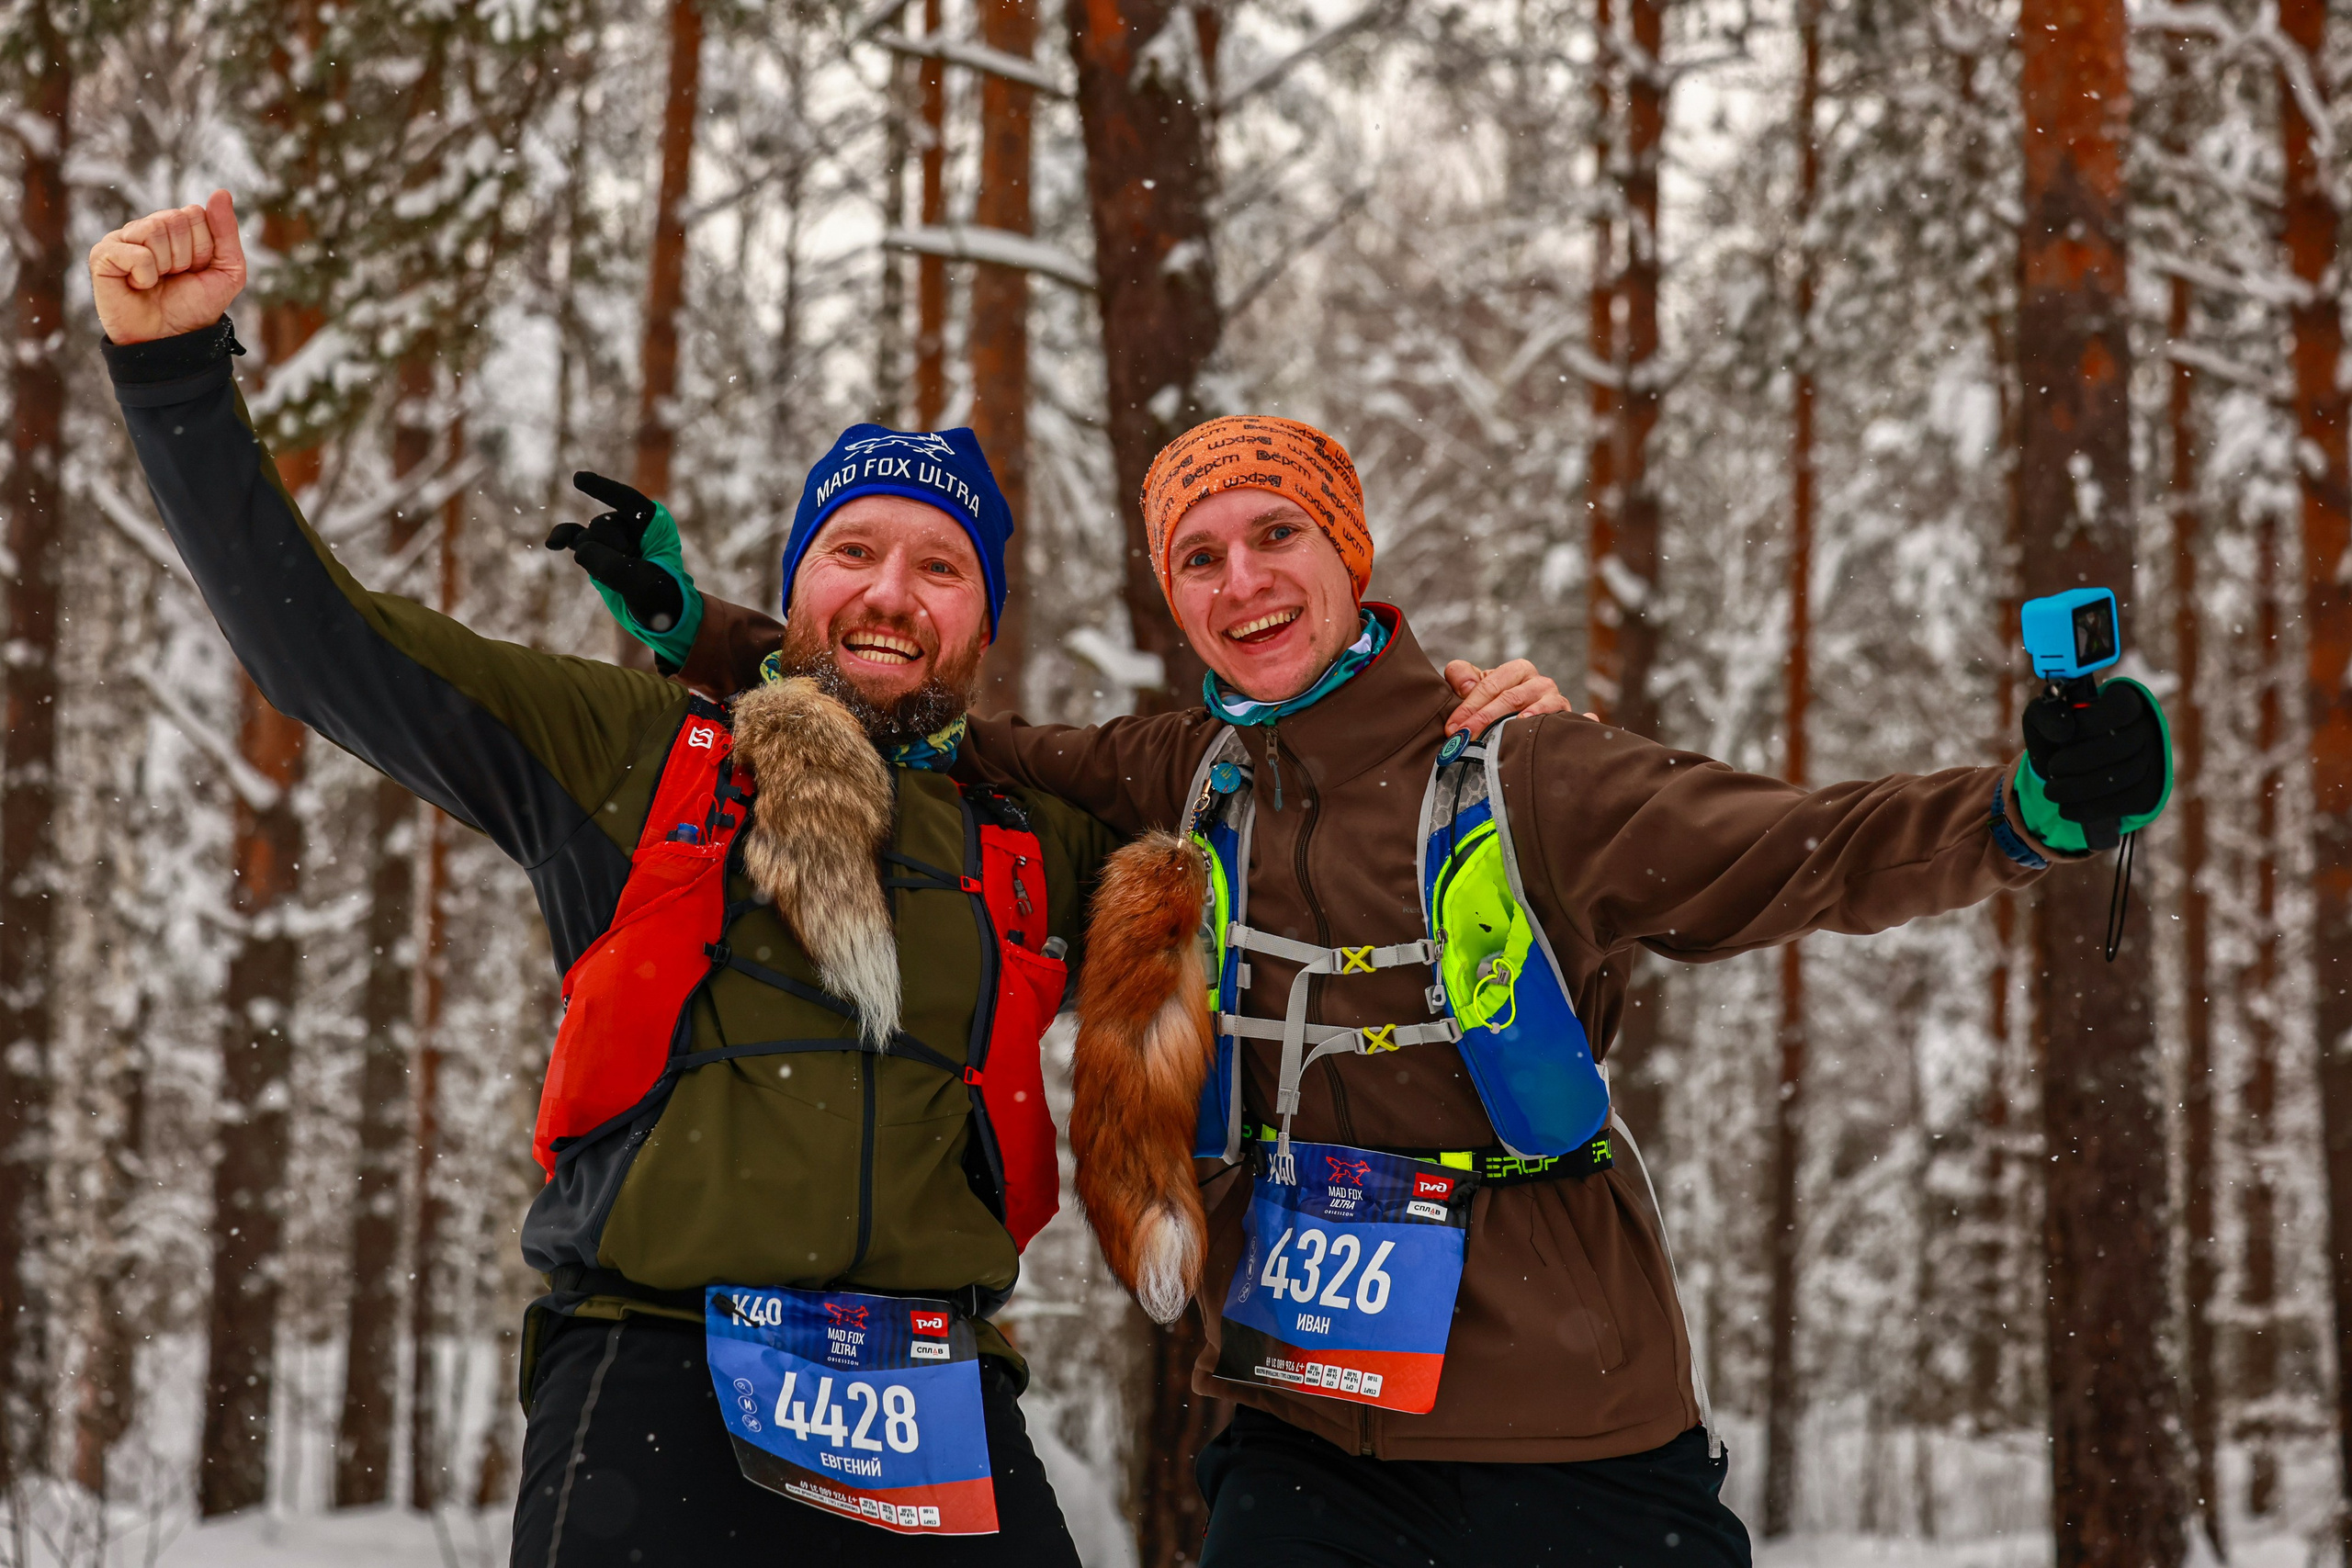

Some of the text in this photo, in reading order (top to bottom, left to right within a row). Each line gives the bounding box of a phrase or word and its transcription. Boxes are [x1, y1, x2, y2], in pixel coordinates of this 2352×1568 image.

[817, 457, 980, 518] MAD FOX ULTRA
[1223, 472, 1282, 488] Вёрст
[1329, 1186, 1363, 1201] MAD FOX
[1329, 1198, 1356, 1210] ULTRA
[1414, 1204, 1441, 1216] СПЛАВ
[1261, 1227, 1396, 1314] 4326
[732, 1294, 782, 1326] K40
[1296, 1313, 1330, 1335] ИВАН
[828, 1327, 865, 1346] MAD FOX
[831, 1341, 857, 1358] ULTRA
[917, 1347, 944, 1356] СПЛАВ
[827, 1357, 859, 1366] OBSESSION
[775, 1371, 919, 1454] 4428
[820, 1451, 882, 1477] ЕВГЕНИЙ
